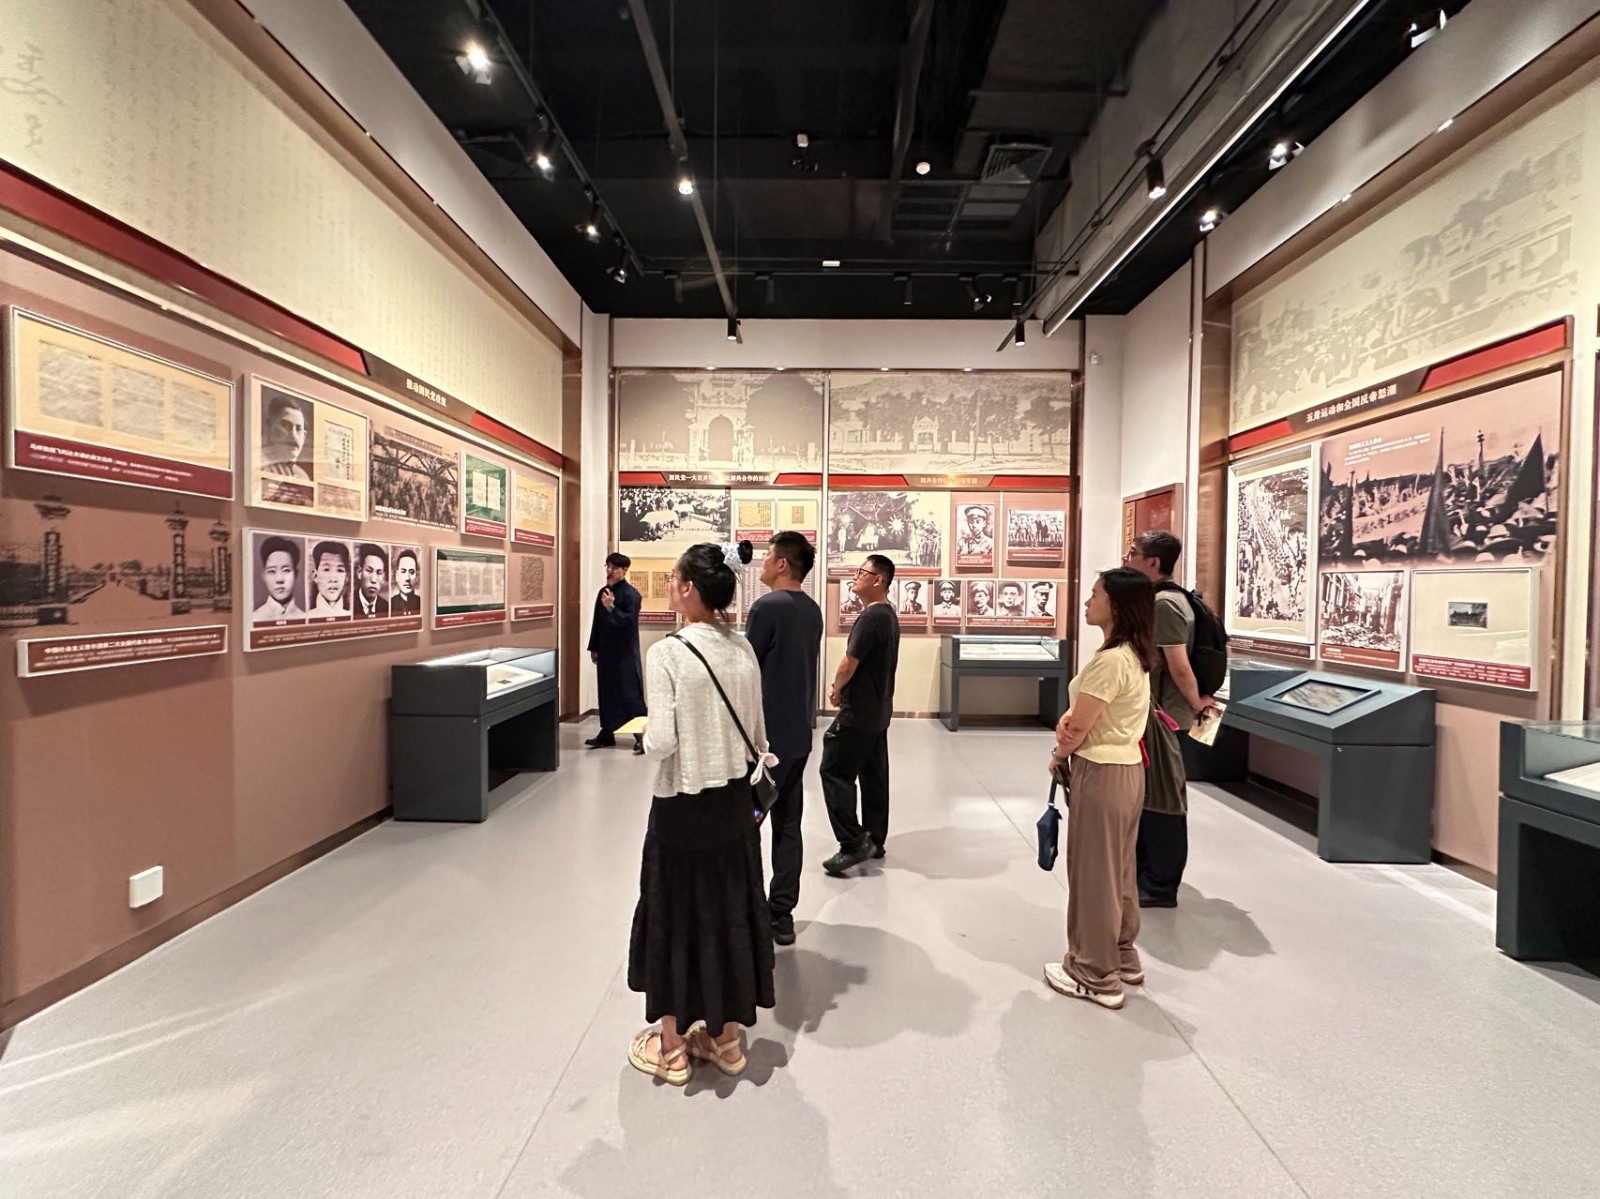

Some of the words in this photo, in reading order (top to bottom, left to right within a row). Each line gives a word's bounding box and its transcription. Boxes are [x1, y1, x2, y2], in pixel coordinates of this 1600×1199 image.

[1306, 384, 1397, 423] 五卅运动和全国反帝怒潮
